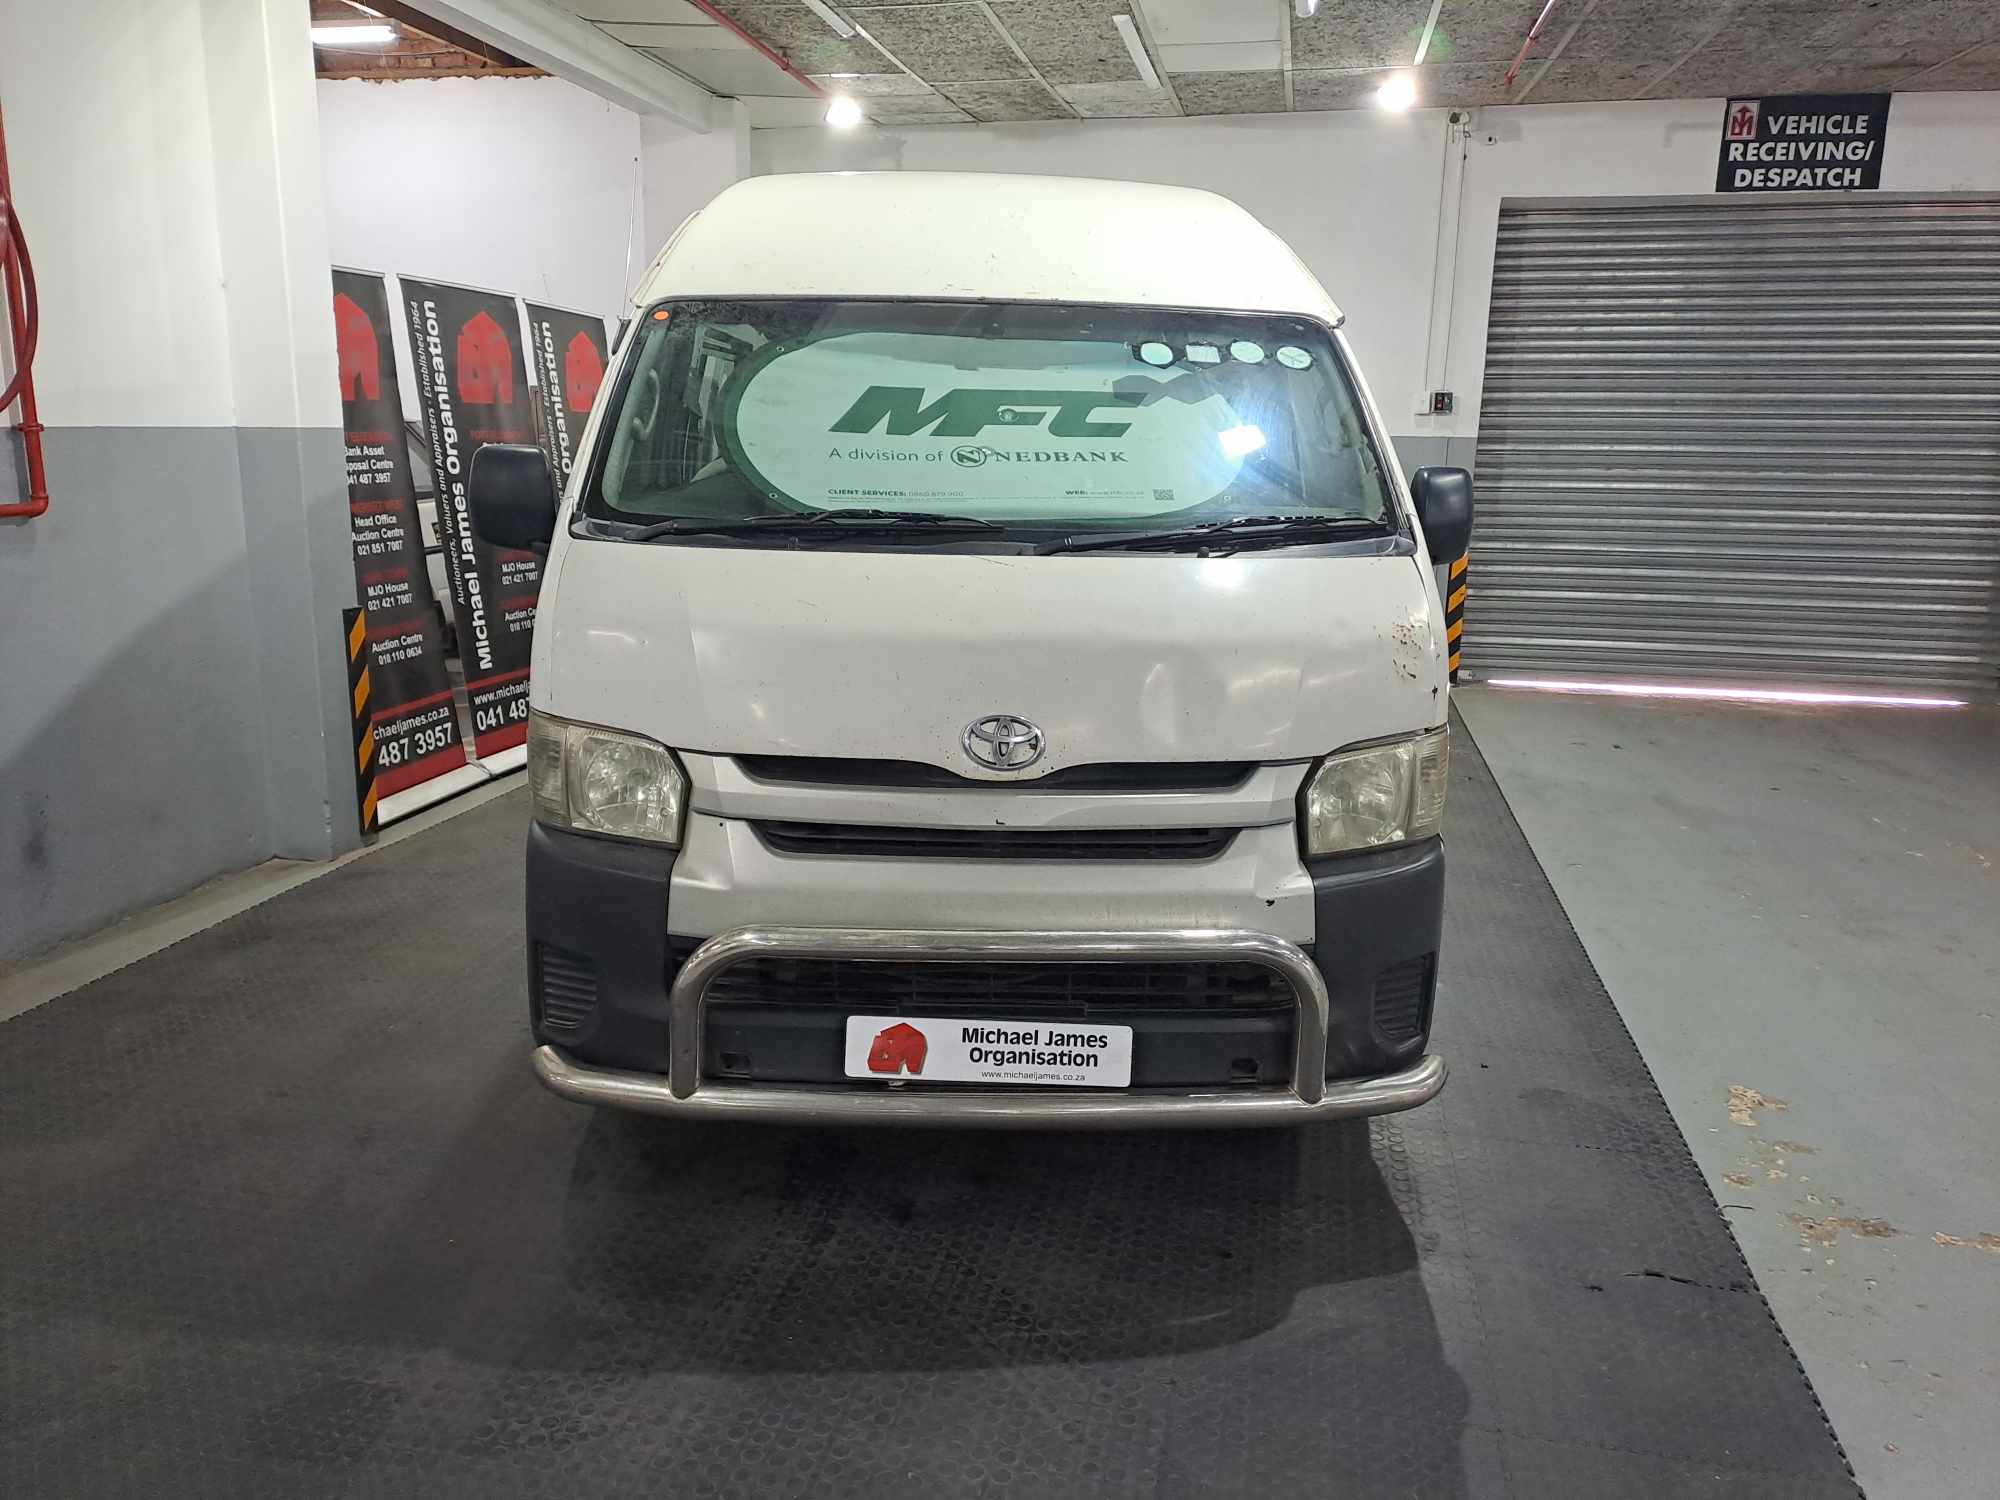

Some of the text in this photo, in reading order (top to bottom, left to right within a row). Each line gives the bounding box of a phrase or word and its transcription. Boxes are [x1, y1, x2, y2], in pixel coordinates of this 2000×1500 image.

[1767, 115, 1869, 135] VEHICLE
[1728, 140, 1875, 162] RECEIVING/
[1734, 167, 1862, 188] DESPATCH
[410, 300, 422, 330] 1964
[414, 331, 432, 398] Established
[541, 321, 573, 475] Organisation
[427, 407, 444, 468] Appraisers
[363, 446, 384, 455] Asset
[829, 448, 842, 459] A
[848, 447, 919, 461] division
[925, 447, 944, 461] of
[995, 451, 1129, 463] NEDBANK
[359, 473, 372, 484] 487
[374, 472, 391, 483] 3957
[423, 300, 493, 670] Michael James Organisation
[435, 467, 447, 492] and
[354, 513, 397, 527] Head Office
[442, 493, 454, 535] Valuers
[351, 530, 380, 542] Auction
[357, 544, 370, 555] 021
[516, 561, 536, 571] House
[367, 582, 409, 597] MJO House
[367, 599, 380, 611] 021
[381, 596, 395, 608] 421
[371, 633, 423, 653] Auction Centre
[391, 650, 405, 662] 110
[476, 697, 528, 731] 041 48
[378, 722, 453, 768] 487 3957
[961, 1027, 1108, 1049] Michael James
[969, 1047, 1098, 1068] Organisation
[981, 1070, 1086, 1081] www.michaeljames.co.za
